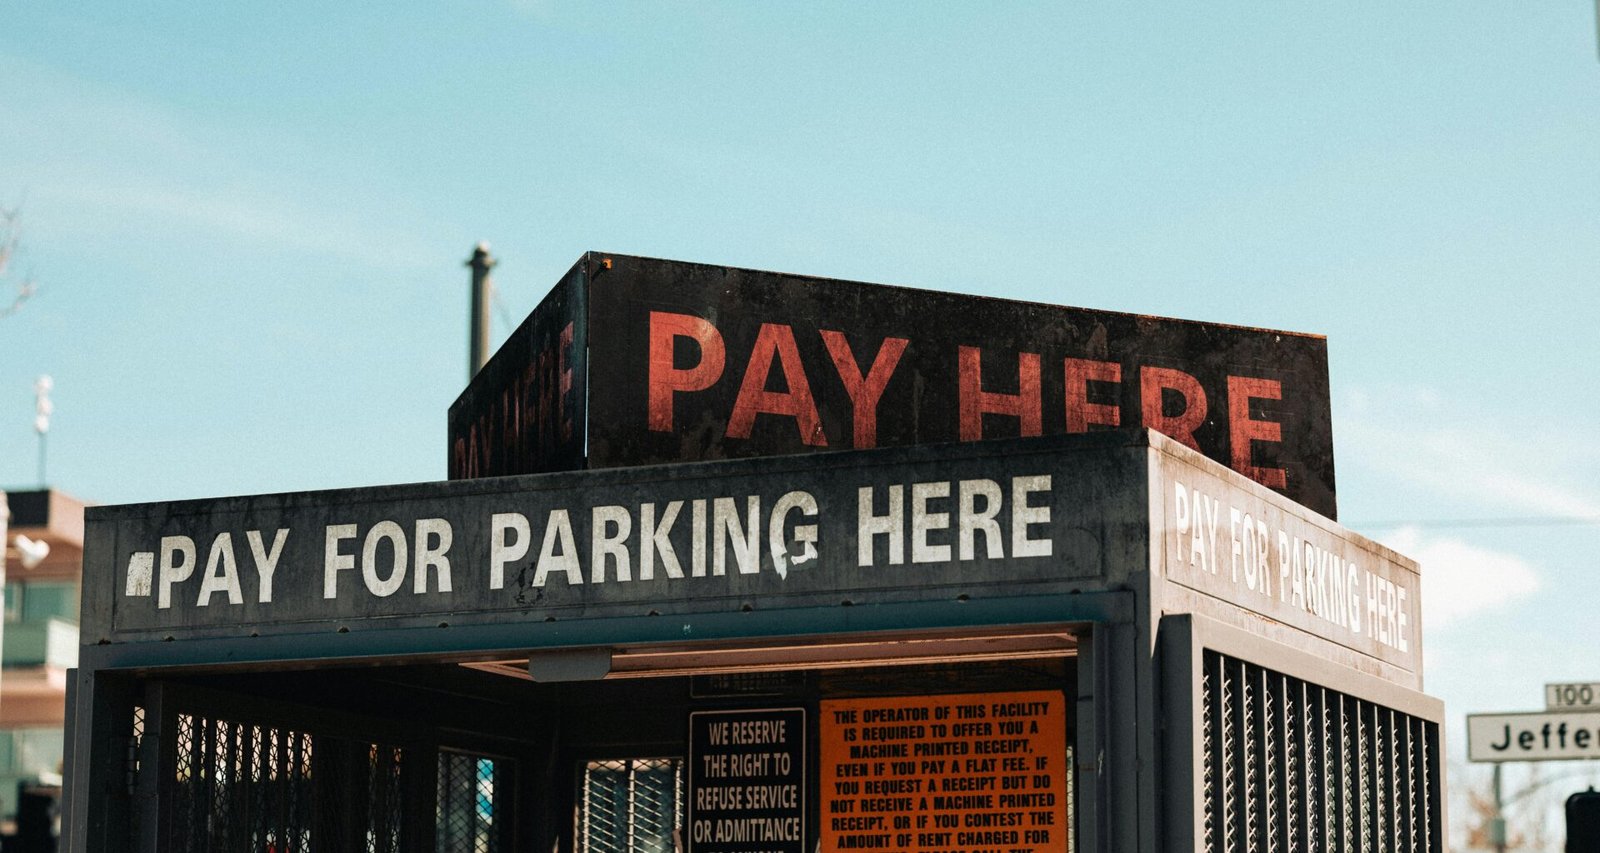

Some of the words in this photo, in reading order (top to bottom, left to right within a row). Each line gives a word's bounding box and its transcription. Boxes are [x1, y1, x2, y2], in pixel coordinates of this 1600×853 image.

[648, 311, 910, 449] PAY
[958, 345, 1287, 489] HERE
[158, 528, 290, 608] PAY
[323, 518, 453, 599] FOR
[489, 491, 819, 590] PARKING
[858, 474, 1053, 567] HERE
[1174, 481, 1219, 575] PAY
[1230, 507, 1272, 597] FOR
[1278, 529, 1361, 633] PARKING
[1366, 570, 1408, 653] HERE
[1555, 684, 1593, 706] 100
[834, 710, 857, 724] THE
[863, 708, 928, 723] OPERATOR
[935, 707, 950, 720] OF
[956, 705, 985, 719] THIS
[992, 702, 1049, 717] FACILITY
[709, 722, 728, 745] WE
[732, 720, 786, 744] RESERVE
[844, 728, 856, 741] IS
[863, 726, 925, 742] REQUIRED
[931, 725, 946, 737] TO
[953, 723, 992, 737] OFFER
[998, 721, 1023, 735] YOU
[1030, 721, 1038, 733] A
[1490, 722, 1600, 751] Jeffe
[850, 744, 908, 759] MACHINE
[914, 741, 969, 756] PRINTED
[975, 739, 1033, 754] RECEIPT,
[704, 755, 727, 777] THE
[731, 753, 770, 777] RIGHT
[774, 752, 790, 776] TO
[836, 764, 868, 777] EVEN
[874, 763, 885, 775] IF
[891, 762, 915, 775] YOU
[921, 760, 945, 774] PAY
[952, 760, 960, 773] A
[966, 758, 997, 772] FLAT
[1003, 757, 1030, 772] FEE.
[1036, 757, 1048, 769] IF
[835, 781, 859, 795] YOU
[865, 780, 922, 796] REQUEST
[928, 779, 936, 792] A
[942, 777, 996, 792] RECEIPT
[1002, 776, 1027, 789] BUT
[1033, 775, 1050, 788] DO
[697, 787, 742, 810] REFUSE
[746, 785, 796, 809] SERVICE
[830, 800, 855, 813] NOT
[861, 798, 913, 812] RECEIVE
[919, 797, 927, 810] A
[934, 795, 993, 810] MACHINE
[999, 793, 1055, 808] PRINTED
[694, 820, 712, 843] OR
[715, 818, 799, 842] ADMITTANCE
[832, 817, 888, 831] RECEIPT,
[894, 816, 910, 829] OR
[917, 815, 928, 828] IF
[934, 814, 959, 828] YOU
[965, 812, 1023, 827] CONTEST
[1029, 812, 1054, 825] THE
[837, 834, 891, 849] AMOUNT
[897, 834, 913, 847] OF
[918, 833, 953, 846] RENT
[957, 831, 1019, 845] CHARGED
[1025, 830, 1049, 844] FOR
